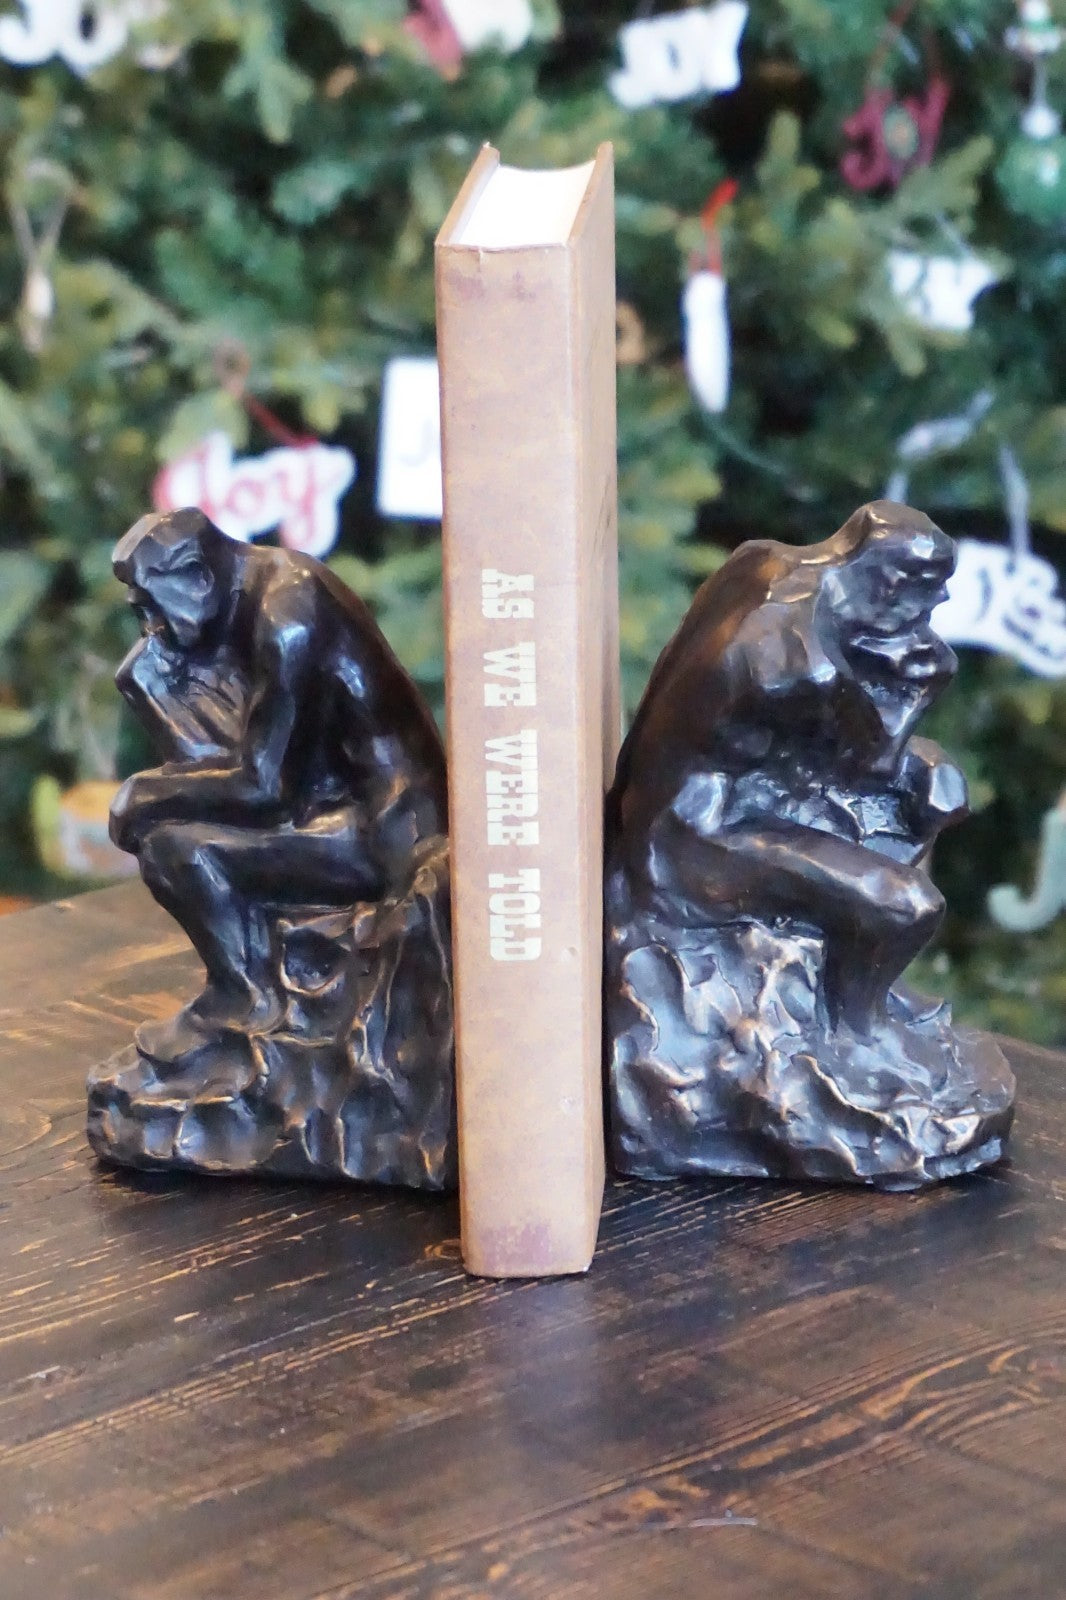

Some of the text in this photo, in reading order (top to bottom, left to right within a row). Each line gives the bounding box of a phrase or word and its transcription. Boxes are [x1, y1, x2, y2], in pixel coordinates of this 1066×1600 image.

[481, 567, 543, 962] AS WE WERE TOLD
